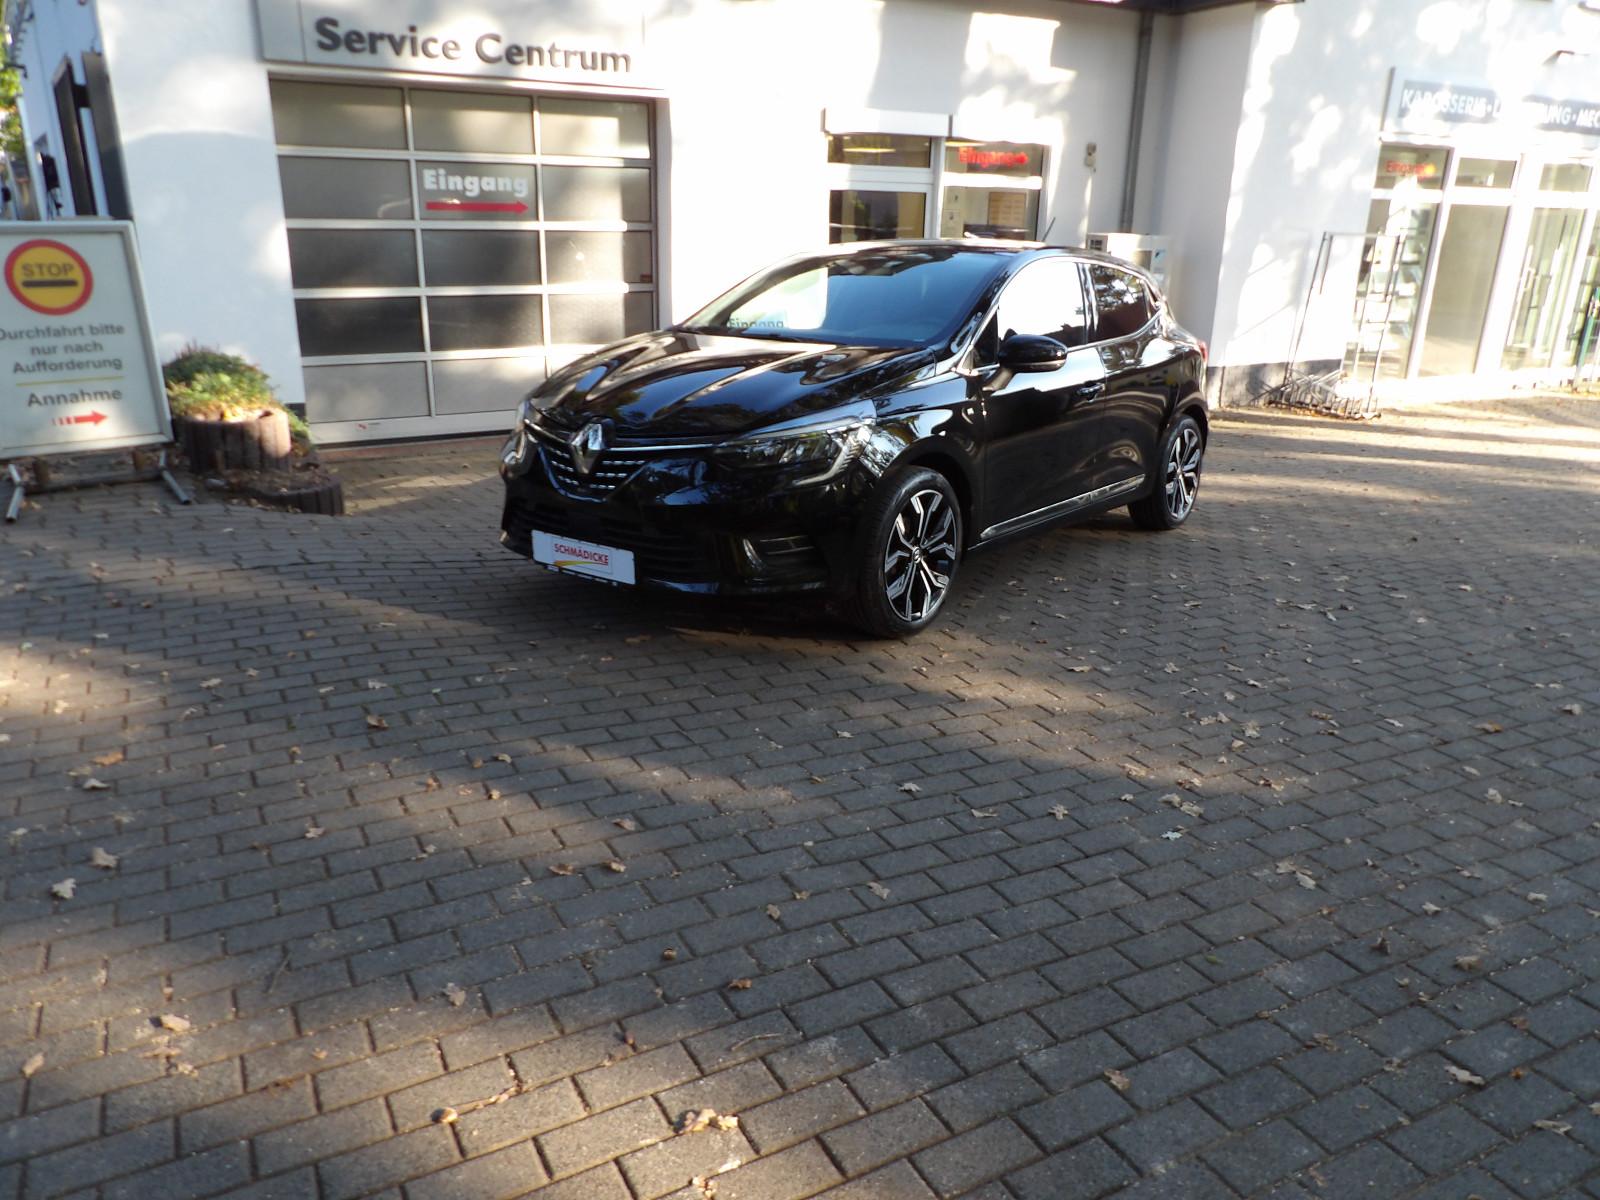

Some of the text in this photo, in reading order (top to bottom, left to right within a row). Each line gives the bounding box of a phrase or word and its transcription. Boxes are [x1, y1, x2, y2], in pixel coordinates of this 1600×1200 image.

[314, 16, 631, 72] Service Centrum
[422, 168, 528, 197] Eingang
[21, 262, 76, 278] STOP
[0, 323, 125, 340] Durchfahrt bitte
[30, 341, 104, 356] nur nach
[13, 358, 123, 374] Aufforderung
[27, 387, 123, 407] Annahme
